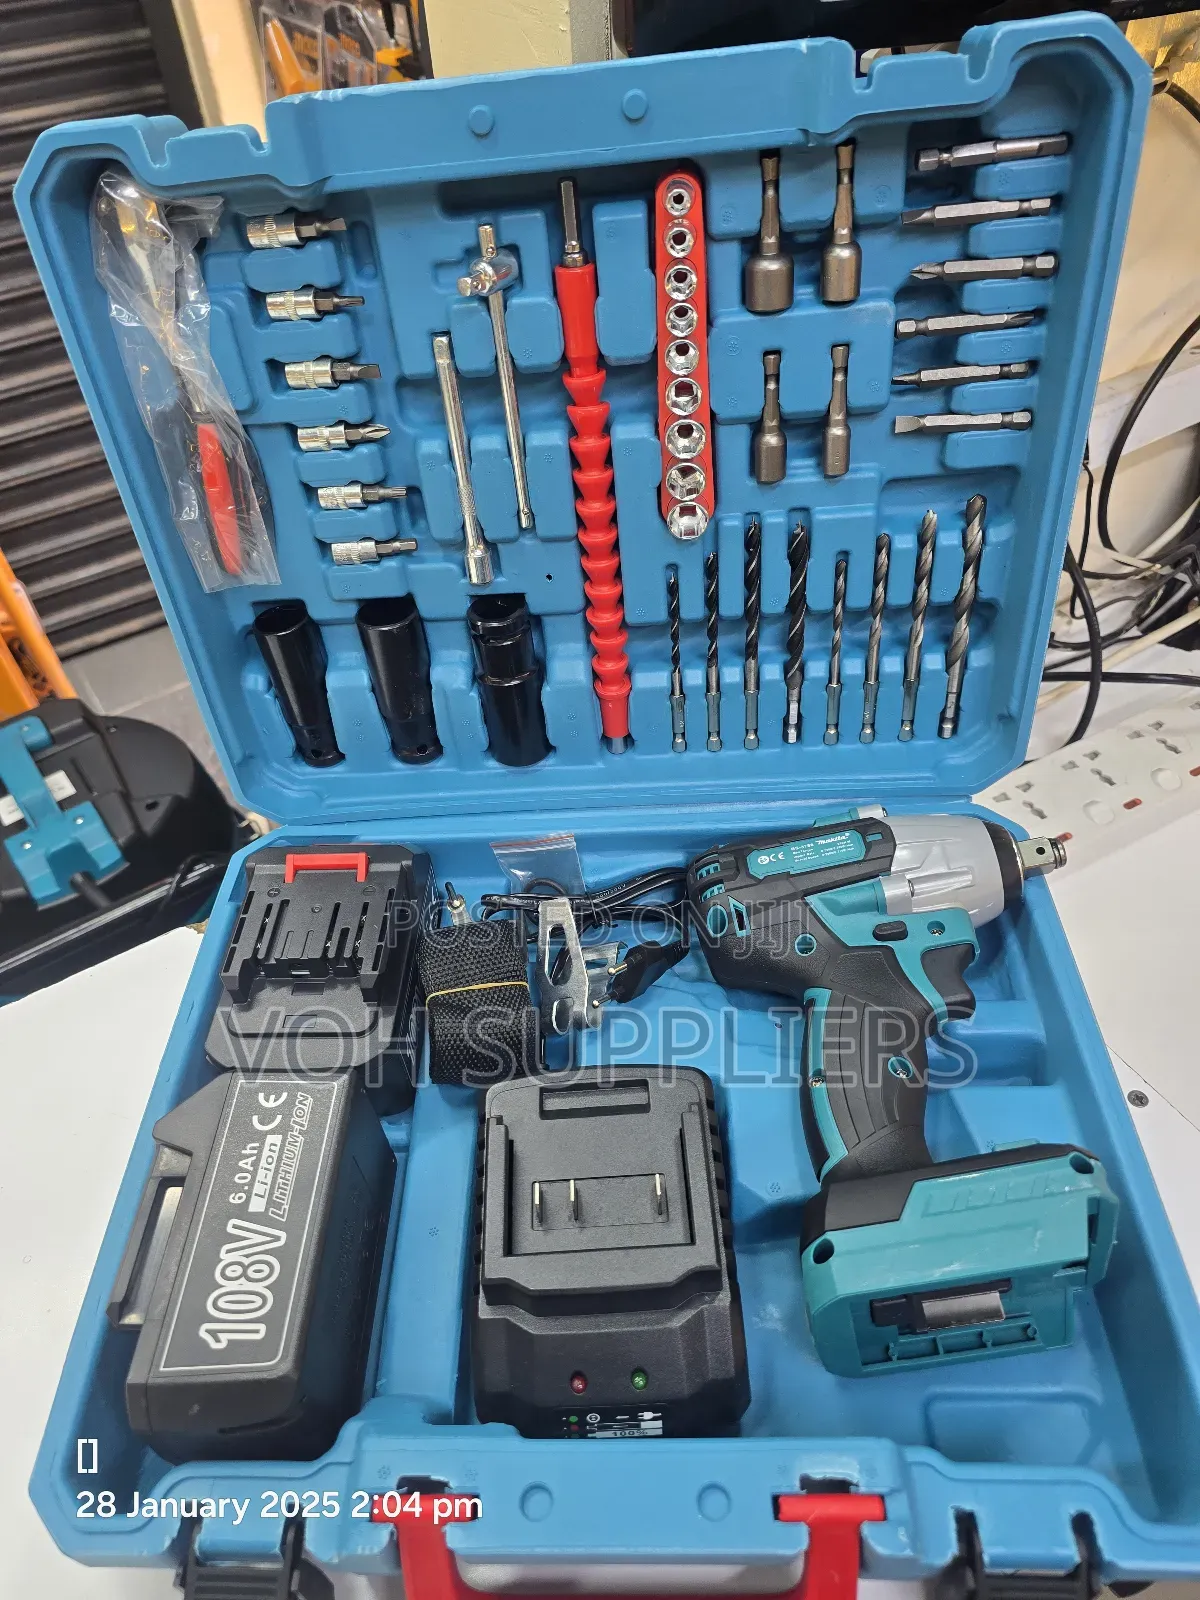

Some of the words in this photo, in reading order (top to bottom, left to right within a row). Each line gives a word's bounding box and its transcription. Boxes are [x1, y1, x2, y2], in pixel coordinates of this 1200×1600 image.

[229, 1142, 260, 1204] 6.0Ah
[254, 1142, 278, 1200] Li-ion
[268, 1091, 313, 1221] LITHIUM-ION
[198, 1218, 287, 1349] 108V
